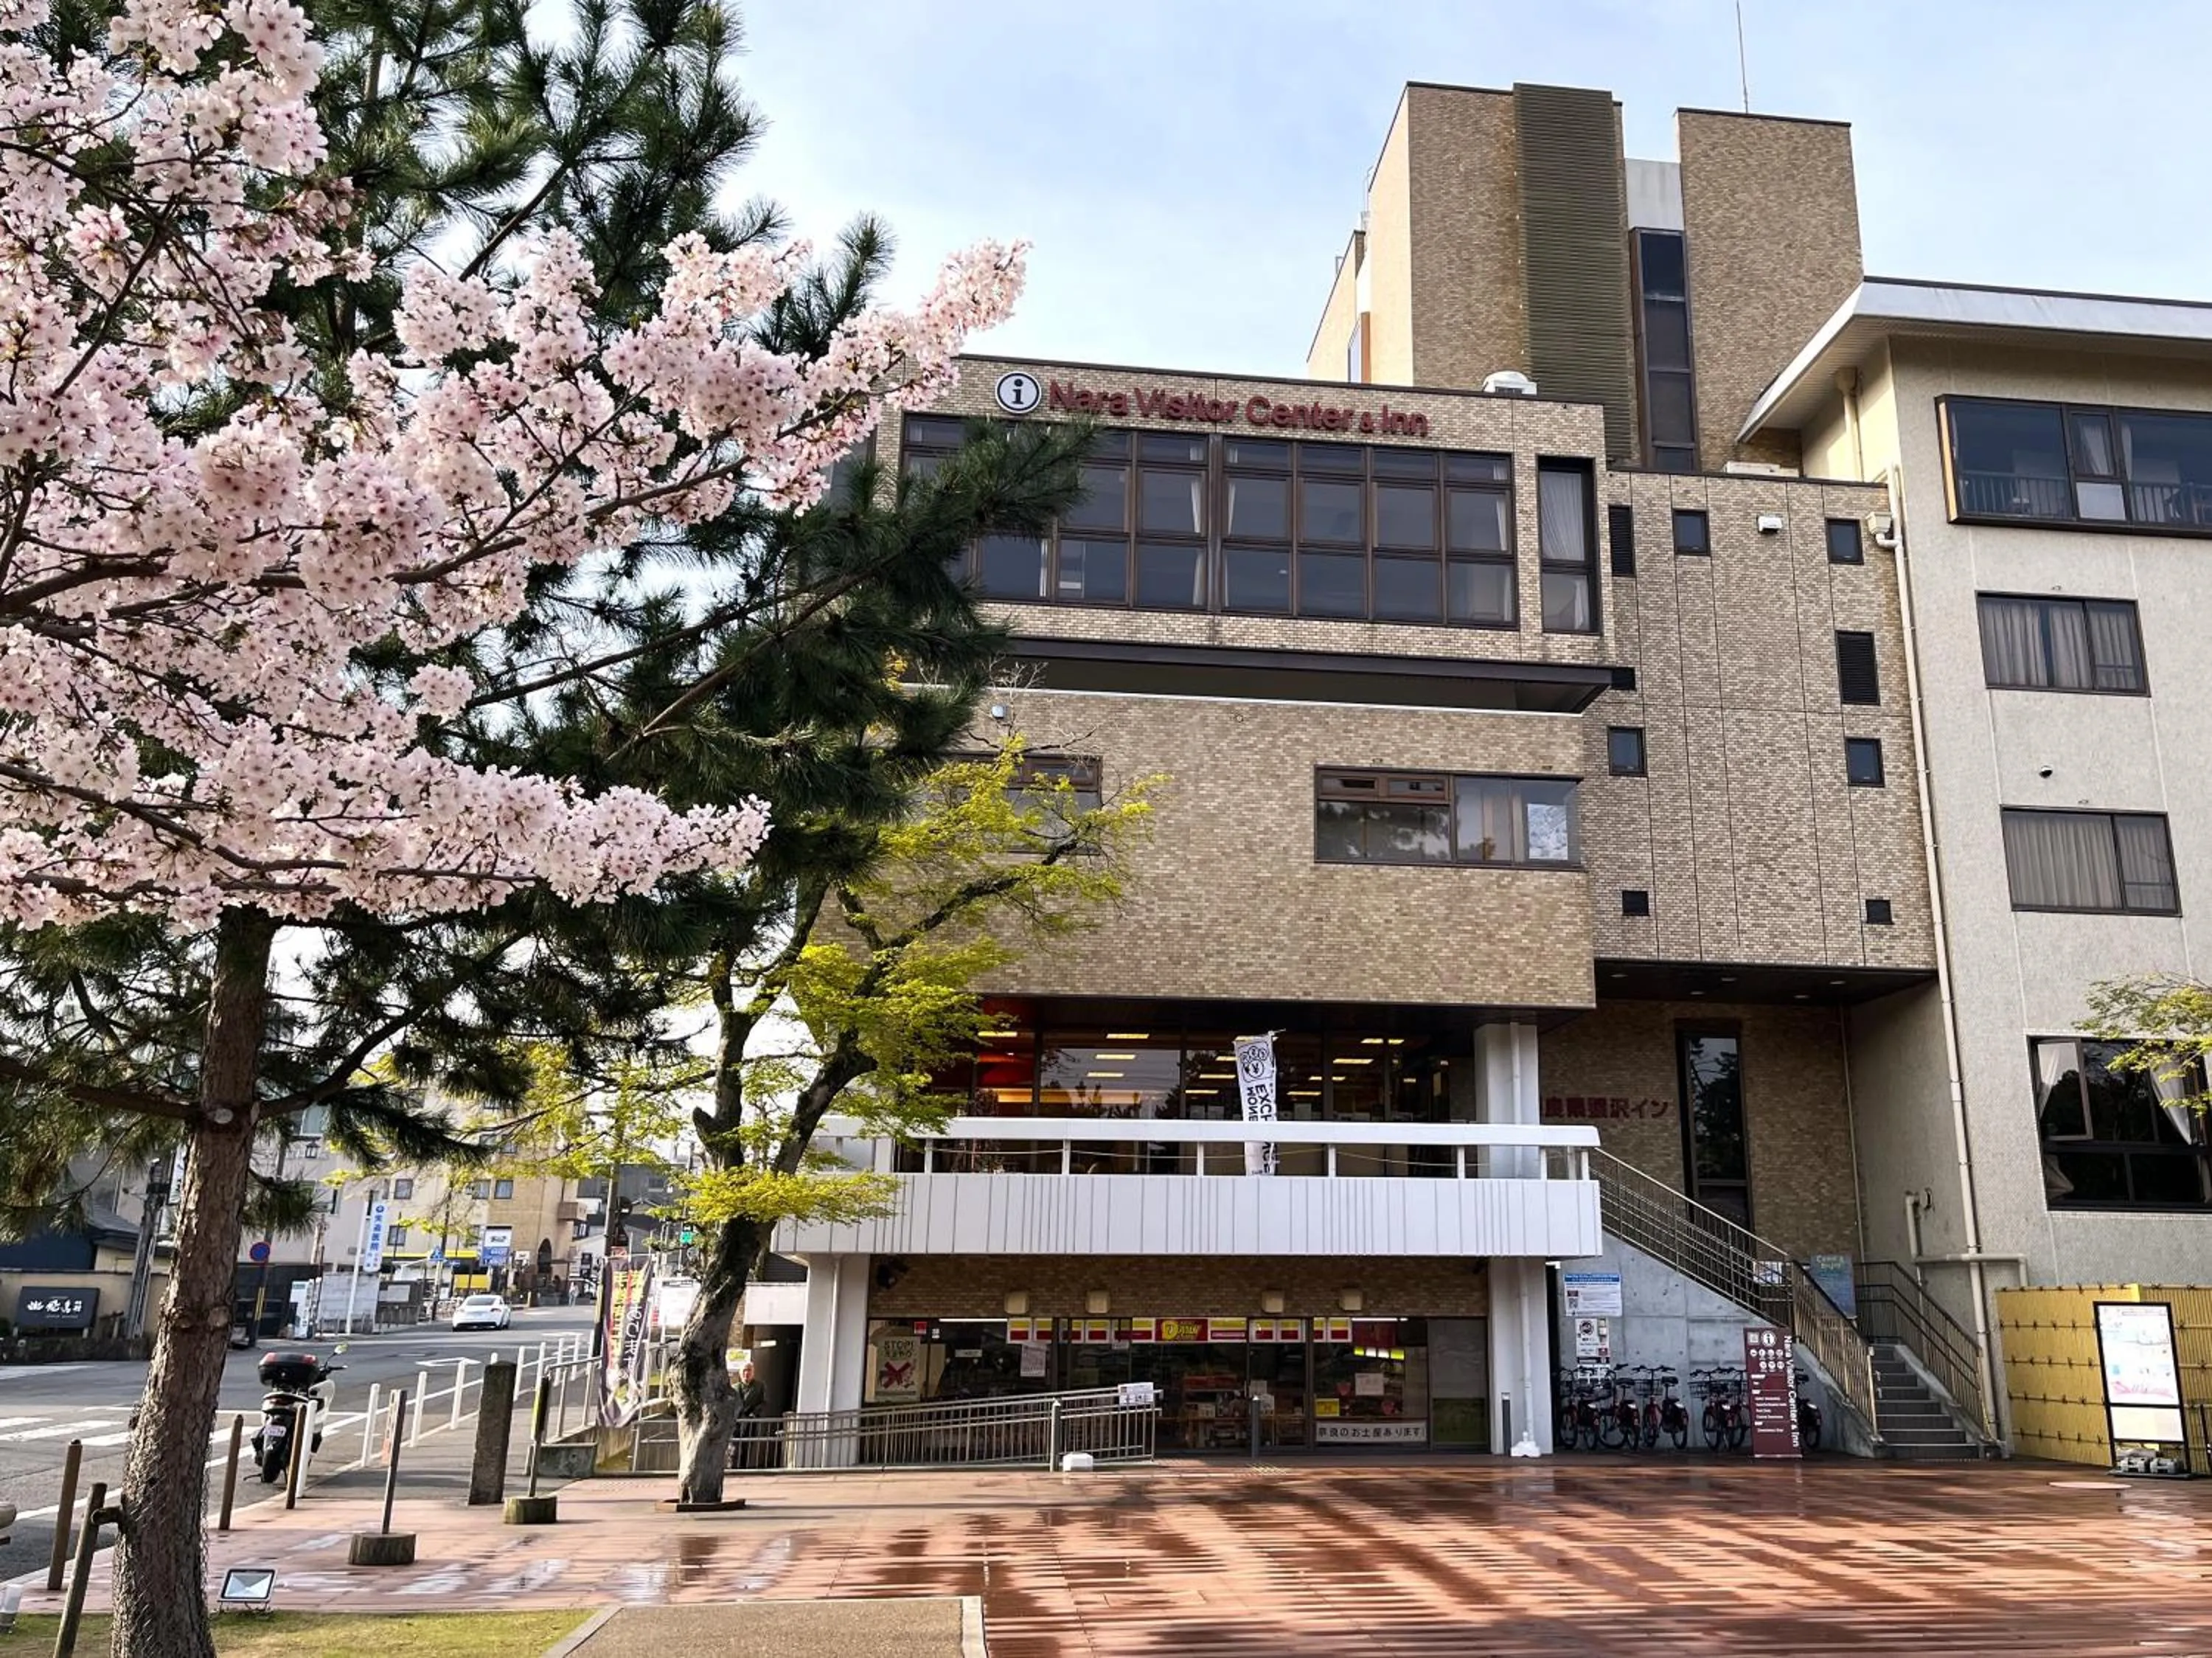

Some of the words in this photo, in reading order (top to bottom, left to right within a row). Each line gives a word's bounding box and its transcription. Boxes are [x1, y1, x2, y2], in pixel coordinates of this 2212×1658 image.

[1048, 379, 1129, 417] Nara
[1133, 386, 1239, 423] Visitor
[1245, 395, 1354, 431] Center
[1358, 411, 1374, 434] &
[1382, 403, 1429, 438] Inn
[1784, 1335, 1793, 1359] Nara
[1788, 1390, 1798, 1422] Center
[1318, 1426, 1421, 1438] 奈良のお土産あります
[1791, 1431, 1800, 1448] Inn
